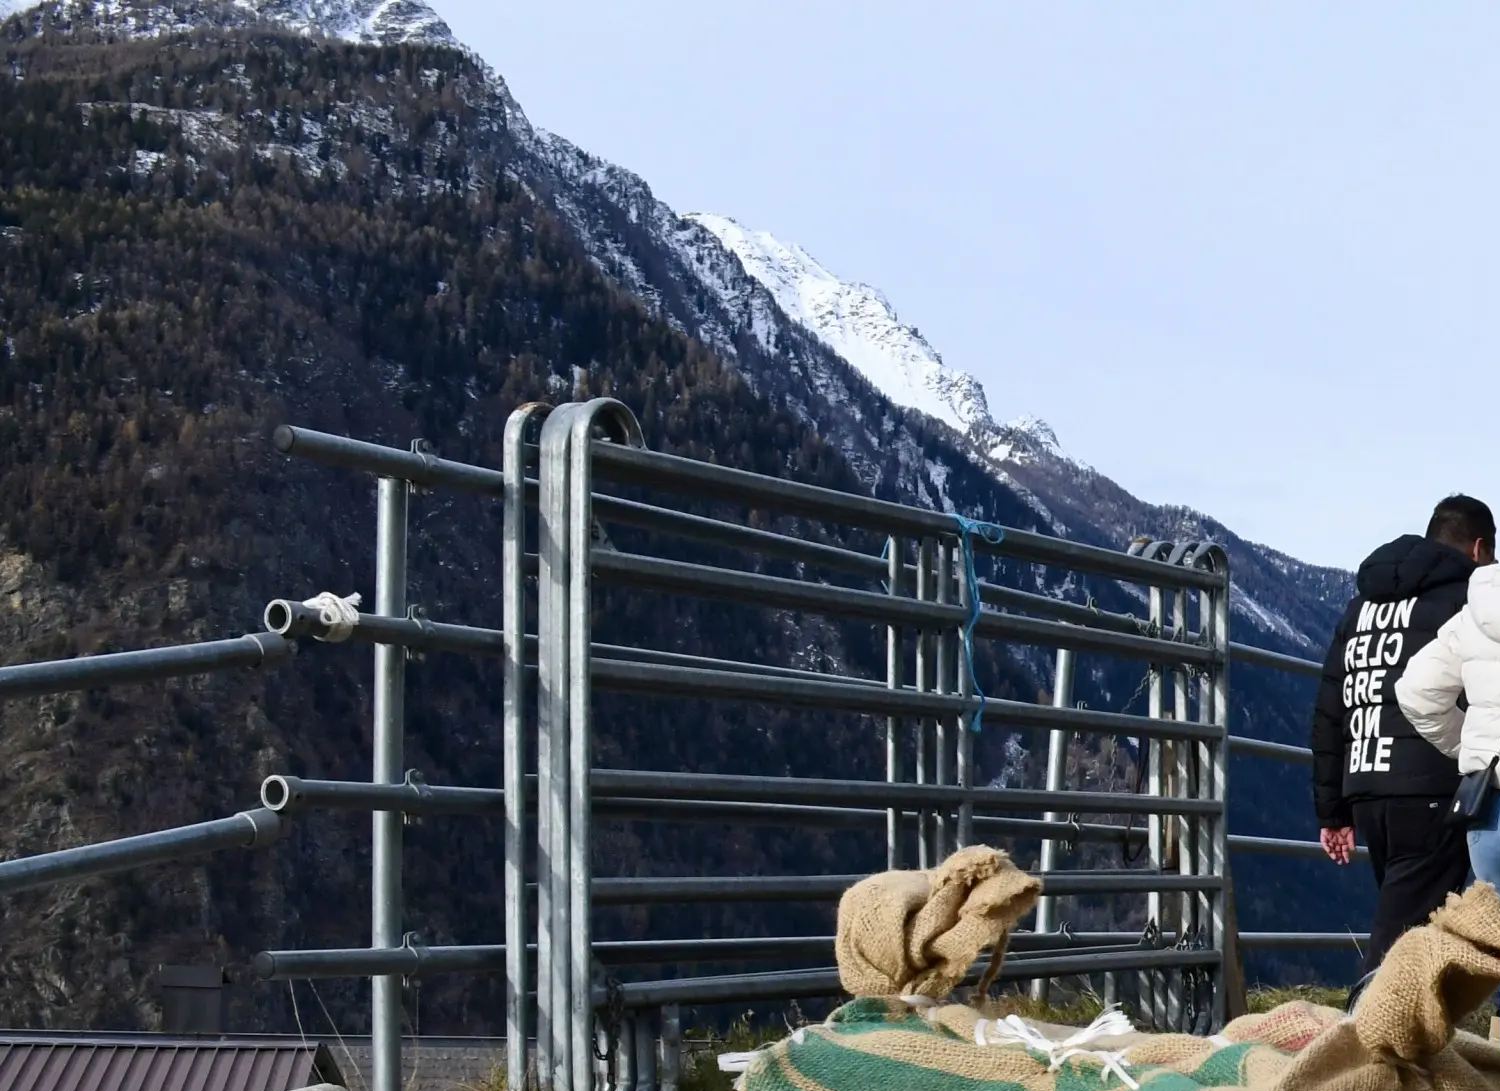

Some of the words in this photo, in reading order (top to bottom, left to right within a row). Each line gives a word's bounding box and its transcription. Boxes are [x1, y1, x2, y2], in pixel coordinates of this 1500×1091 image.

[1356, 597, 1418, 633] MON
[1342, 669, 1387, 708] GRE
[1349, 736, 1394, 774] BLE
